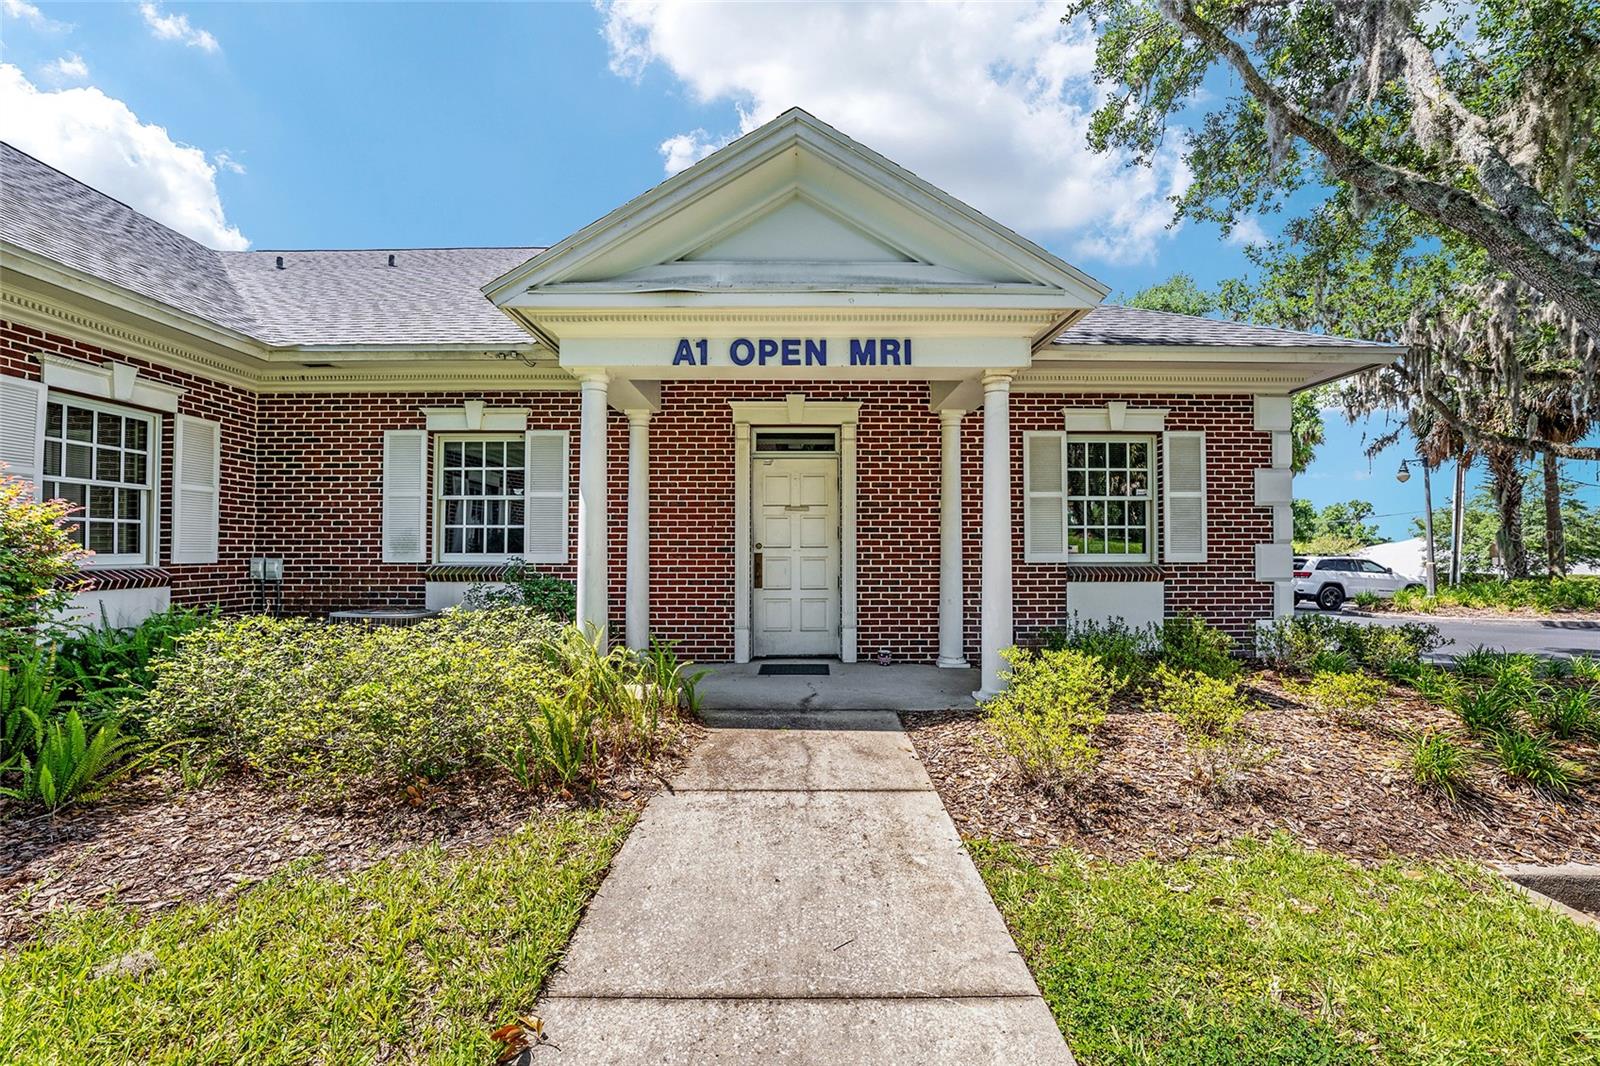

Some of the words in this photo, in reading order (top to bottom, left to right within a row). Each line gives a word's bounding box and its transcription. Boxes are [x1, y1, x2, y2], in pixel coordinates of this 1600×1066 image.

[672, 339, 709, 366] A1
[729, 338, 827, 366] OPEN
[849, 338, 912, 366] MRI
